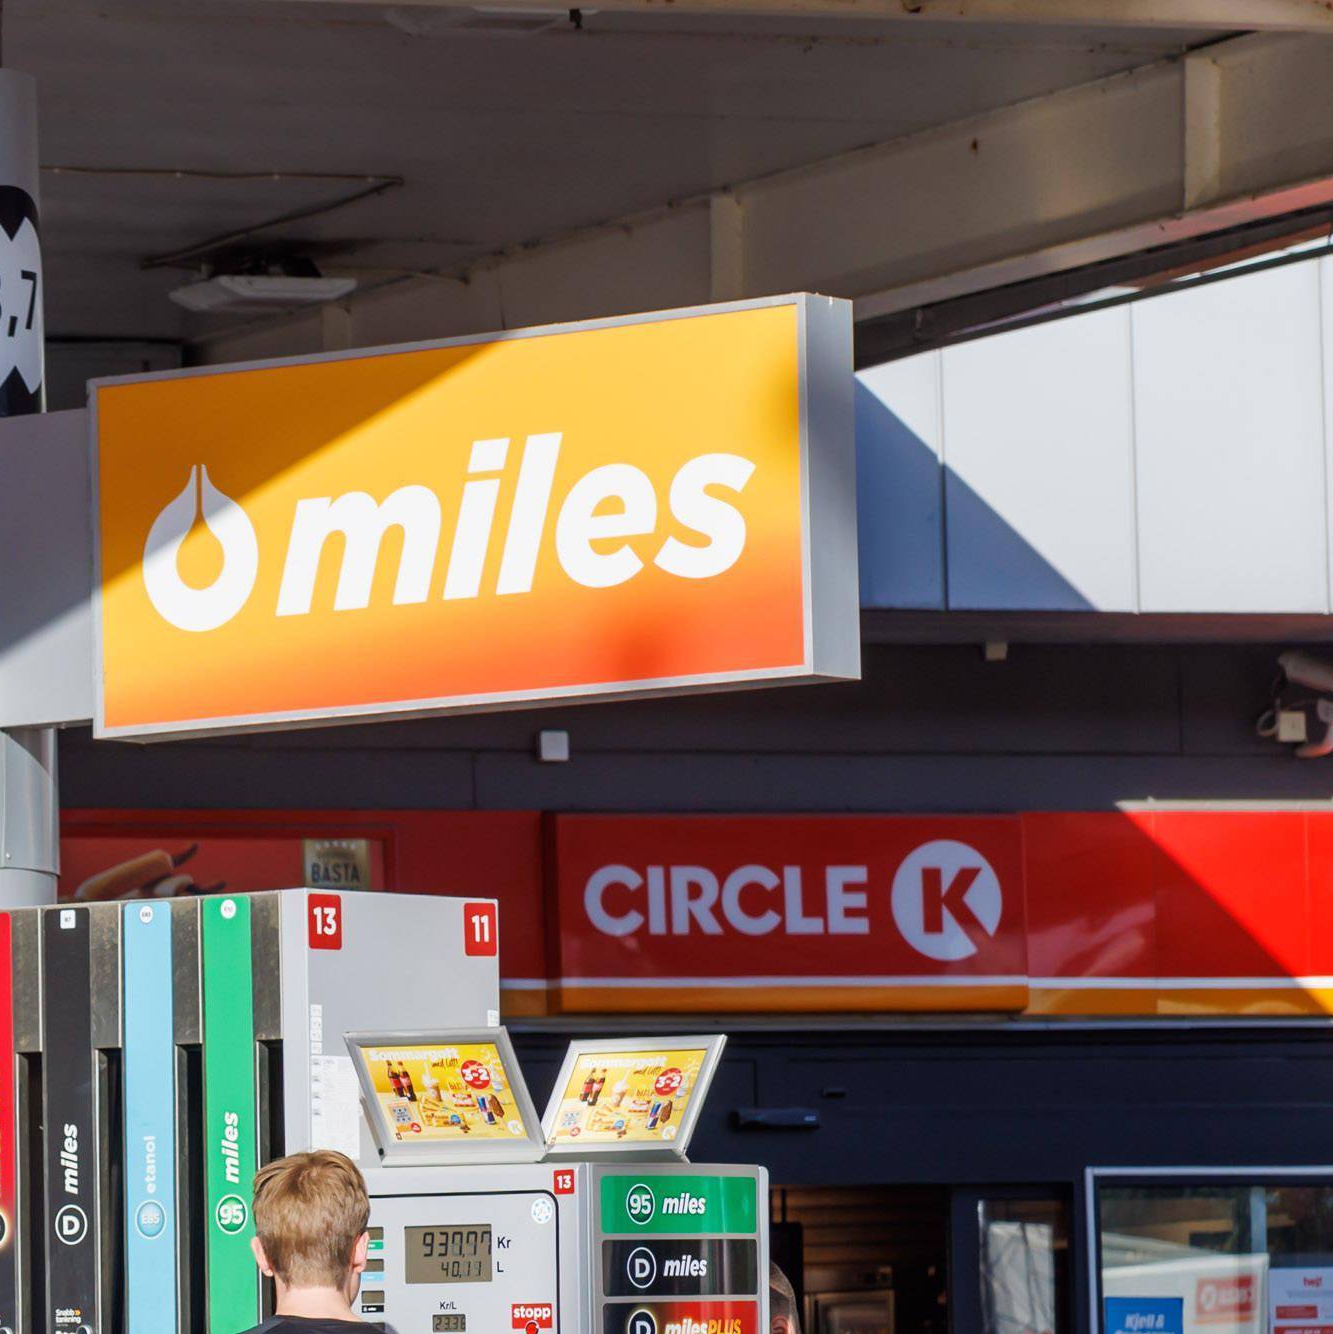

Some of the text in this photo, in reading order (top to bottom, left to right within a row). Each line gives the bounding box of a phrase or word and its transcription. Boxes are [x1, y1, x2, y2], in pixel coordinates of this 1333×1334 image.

[275, 432, 757, 616] miles
[583, 848, 999, 957] CIRCLE K
[313, 906, 337, 936] 13
[471, 914, 490, 942] 11
[221, 1111, 239, 1183] miles
[60, 1123, 78, 1194] miles
[143, 1135, 156, 1193] etanol
[557, 1175, 571, 1189] 13
[630, 1193, 706, 1214] 95 miles
[63, 1215, 80, 1235] D
[219, 1204, 243, 1225] 95
[497, 1237, 511, 1249] Kr
[497, 1262, 504, 1273] L
[635, 1255, 707, 1278] D miles
[439, 1302, 457, 1310] Kr/L
[513, 1307, 551, 1319] stopp
[1125, 1313, 1165, 1330] Kjell &
